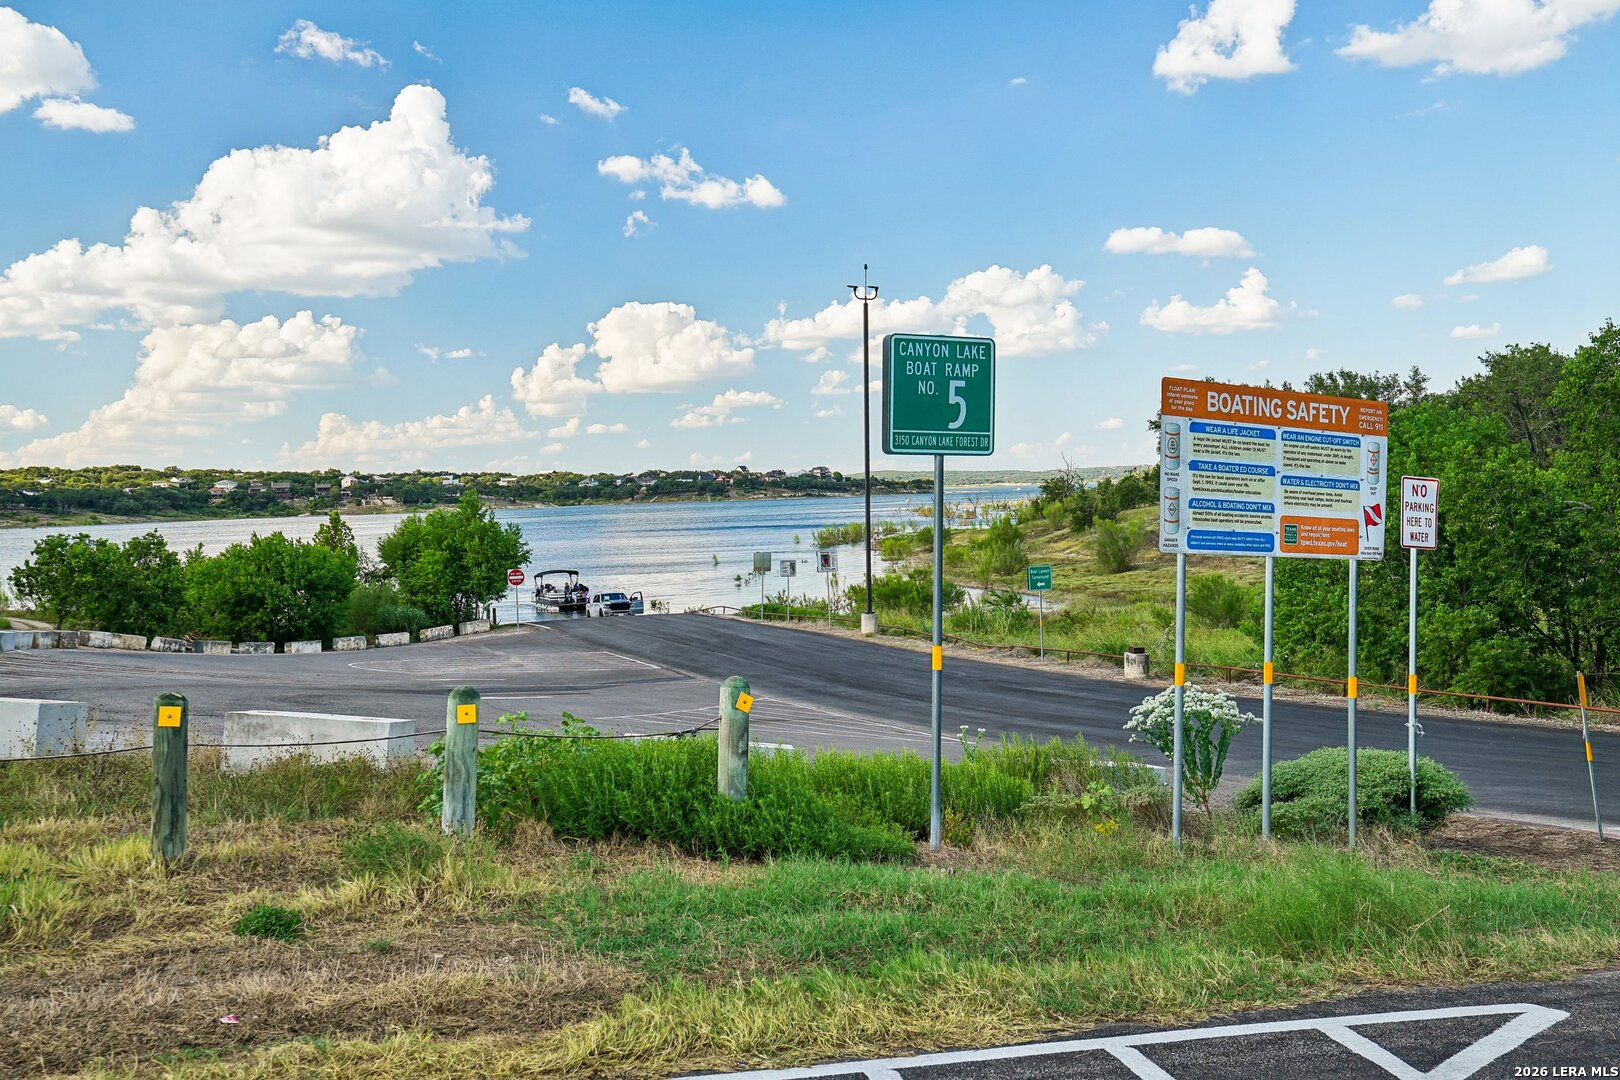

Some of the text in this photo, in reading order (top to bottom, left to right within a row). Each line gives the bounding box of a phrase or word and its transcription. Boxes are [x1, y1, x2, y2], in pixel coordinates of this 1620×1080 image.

[900, 342, 986, 360] CANYON LAKE
[906, 361, 978, 377] BOAT RAMP
[918, 380, 967, 429] NO. 5
[1207, 391, 1350, 424] BOATING SAFETY
[1240, 429, 1260, 437] JACKET
[894, 435, 988, 447] 3150 CANYON LAKE FOREST DR
[1323, 437, 1342, 445] CUT-OFF
[1305, 480, 1335, 488] ELECTRICITY
[1412, 484, 1427, 498] NO
[1405, 502, 1434, 513] PARKING
[1407, 517, 1432, 528] HERE TO
[1410, 532, 1429, 542] WATER
